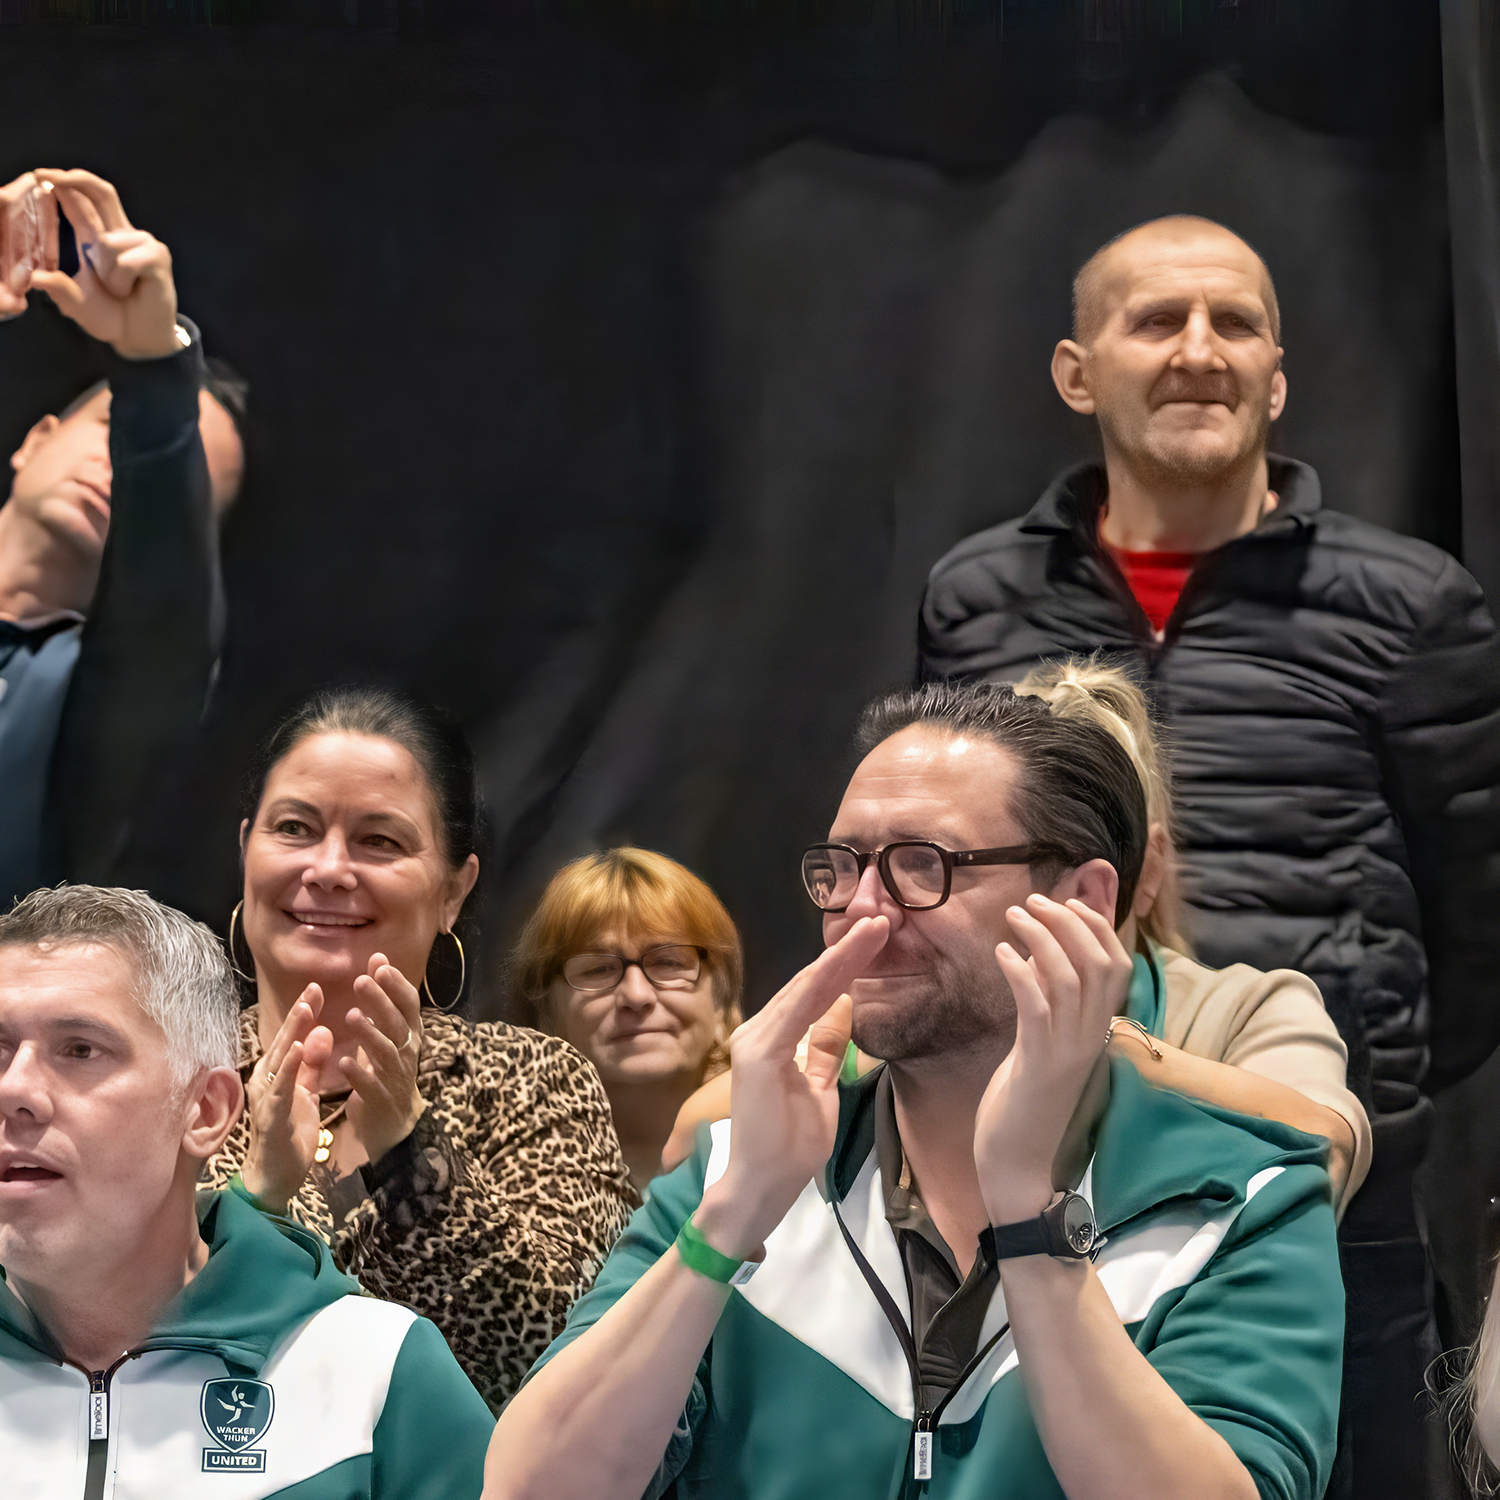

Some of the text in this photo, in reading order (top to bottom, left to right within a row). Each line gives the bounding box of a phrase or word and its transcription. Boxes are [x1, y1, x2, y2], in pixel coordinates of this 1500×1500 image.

[216, 1426, 256, 1435] WACKER
[223, 1434, 248, 1442] THUN
[211, 1455, 257, 1466] UNITED
